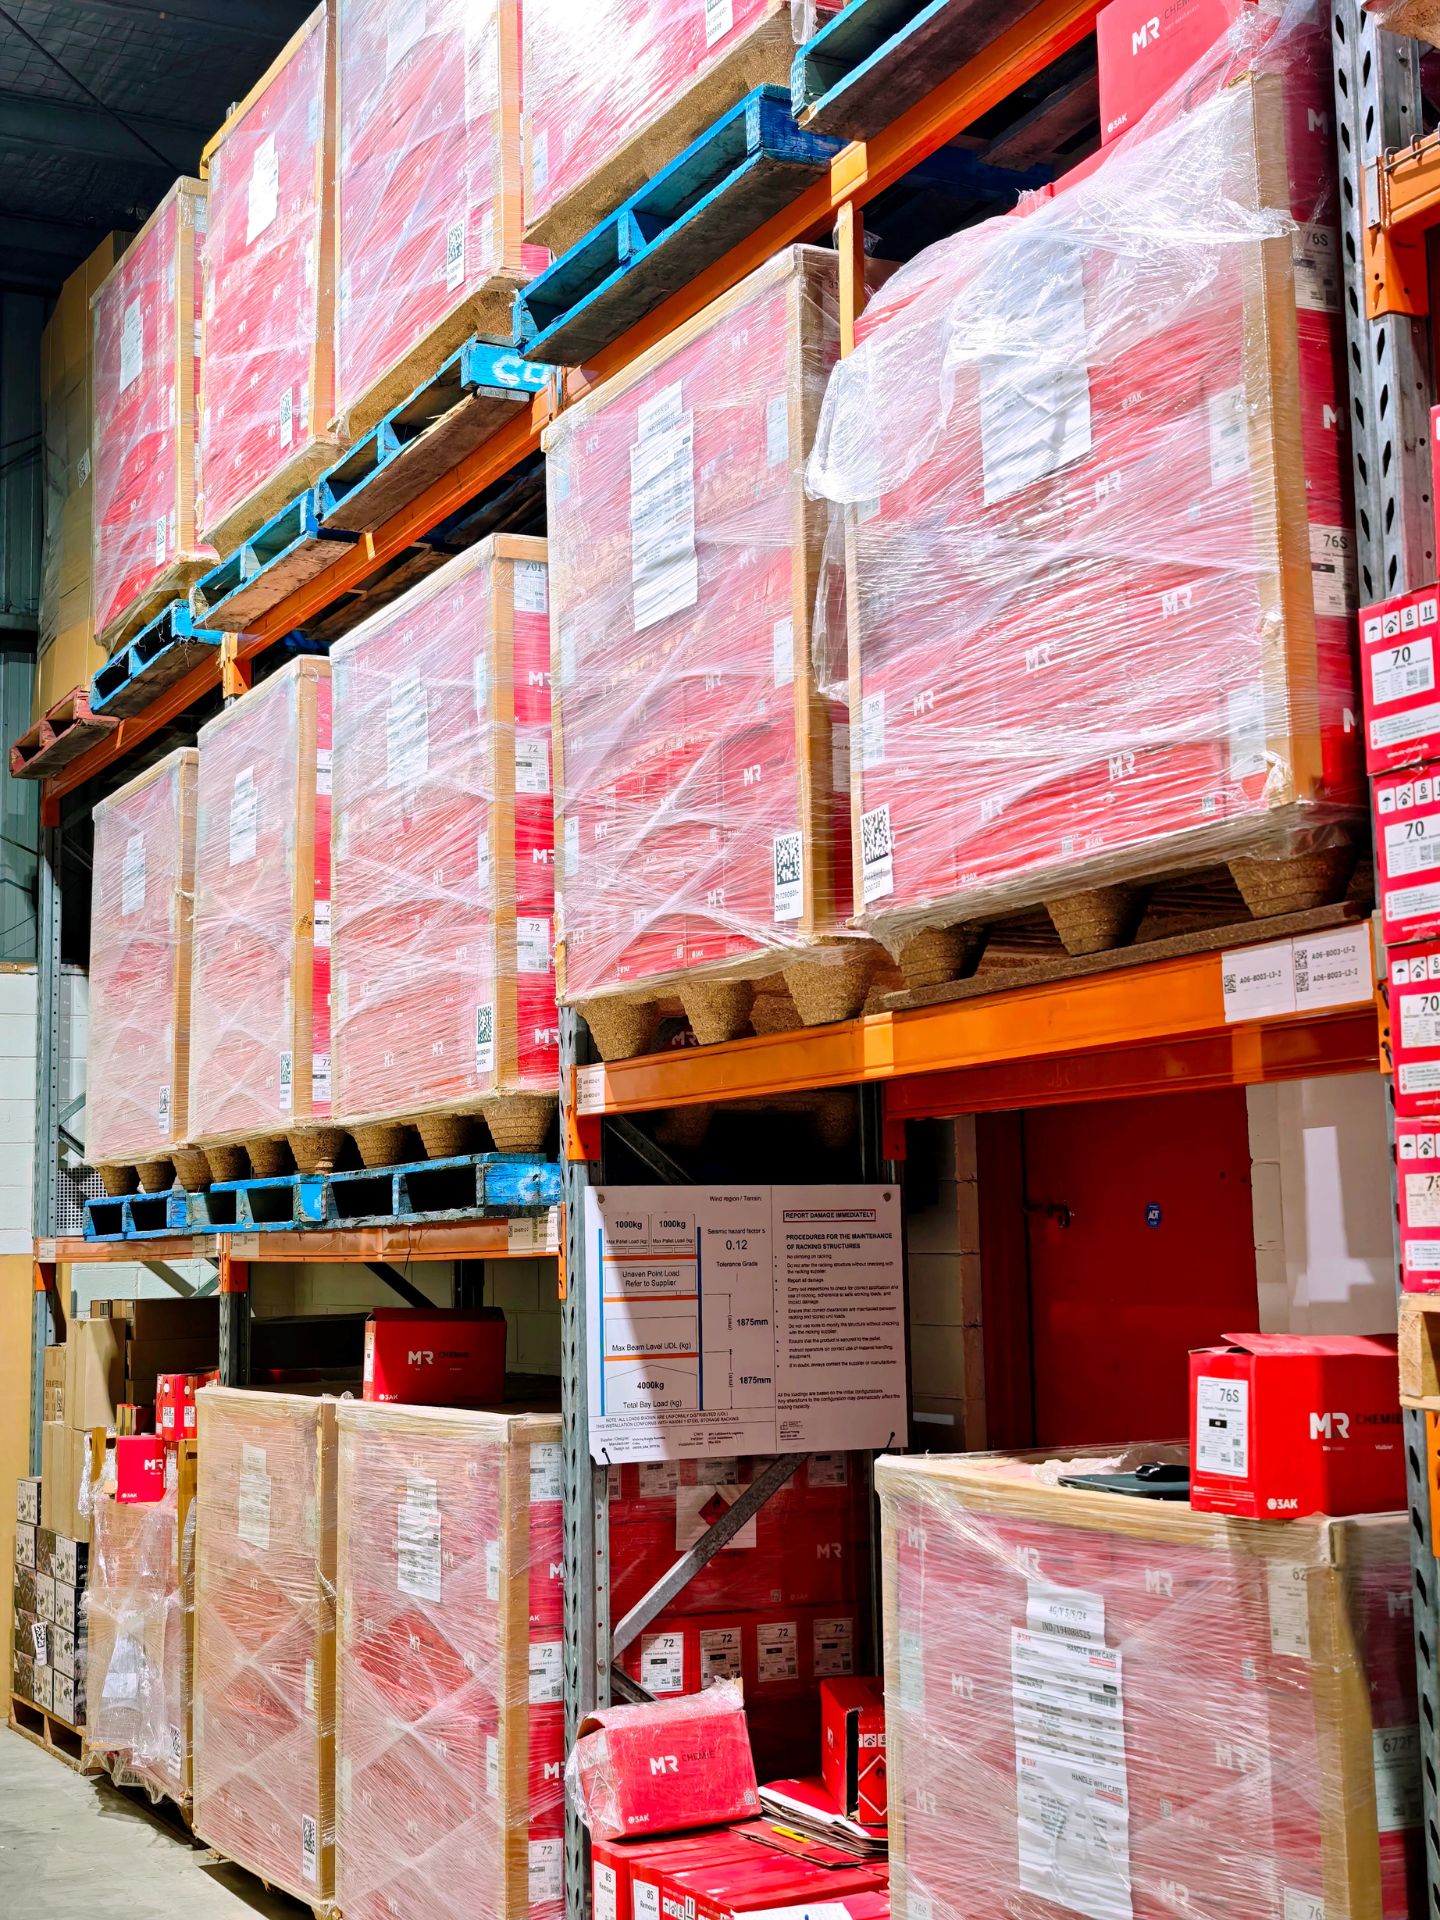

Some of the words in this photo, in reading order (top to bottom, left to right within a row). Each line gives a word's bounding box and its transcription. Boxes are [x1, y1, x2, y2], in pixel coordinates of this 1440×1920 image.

[1131, 16, 1160, 57] MR
[1113, 112, 1128, 130] 3AK
[1307, 108, 1329, 135] M
[731, 329, 749, 351] MR
[1322, 404, 1345, 430] M
[1323, 534, 1348, 549] 76S
[1161, 587, 1193, 620] MR
[1406, 609, 1413, 621] 6
[1025, 642, 1050, 673] MR
[1391, 646, 1412, 666] 70
[706, 672, 722, 691] MR
[913, 690, 935, 716] MR
[527, 744, 539, 753] 72
[1108, 752, 1135, 782] MR
[743, 765, 762, 787] MR
[1420, 782, 1426, 795] 6
[1404, 820, 1425, 840] 70
[707, 888, 725, 908] MR
[529, 923, 541, 932] 72
[1420, 995, 1439, 1013] 70
[1148, 1210, 1160, 1220] ADT
[615, 1220, 643, 1230] 1000kg
[659, 1220, 686, 1230] 1000kg
[725, 1239, 748, 1250] 0.12
[651, 1279, 676, 1288] Supplier
[736, 1318, 769, 1326] 1875mm
[679, 1342, 691, 1350] (kg)
[407, 1351, 434, 1365] MR
[637, 1381, 665, 1390] 4000kg
[739, 1376, 772, 1384] 1875mm
[1219, 1388, 1240, 1403] 76S
[623, 1401, 638, 1409] Total
[639, 1401, 651, 1409] Bay
[653, 1400, 669, 1408] Load
[669, 1400, 682, 1408] (kg)
[1309, 1412, 1350, 1440] MR
[541, 1448, 553, 1457] 72
[144, 1459, 163, 1471] MR
[1276, 1498, 1298, 1509] 3AK
[907, 1526, 928, 1551] MR
[816, 1542, 842, 1559] MR
[1015, 1545, 1041, 1573] MR
[549, 1562, 566, 1579] M
[1144, 1567, 1173, 1598] MR
[1386, 1591, 1410, 1618] M
[529, 1614, 541, 1622] AK
[777, 1628, 789, 1637] 72
[833, 1623, 844, 1633] 72
[663, 1638, 674, 1648] 72
[721, 1633, 733, 1643] 72
[541, 1648, 553, 1657] 72
[1066, 1643, 1088, 1656] HANDLE
[1088, 1648, 1101, 1658] WITH
[1101, 1650, 1117, 1661] CARE
[951, 1672, 974, 1700] MR
[649, 1755, 680, 1776] MR
[681, 1750, 715, 1763] CHEMIE
[1071, 1772, 1092, 1786] HANDLE
[1093, 1779, 1107, 1789] WITH
[1107, 1784, 1123, 1795] CARE
[915, 1788, 936, 1815] MR
[634, 1813, 650, 1824] 3AK
[541, 1845, 553, 1855] 72
[605, 1871, 612, 1883] 85
[599, 1881, 614, 1895] Remover
[646, 1889, 654, 1901] 85
[639, 1900, 657, 1913] Remover
[1307, 1905, 1322, 1920] 76
